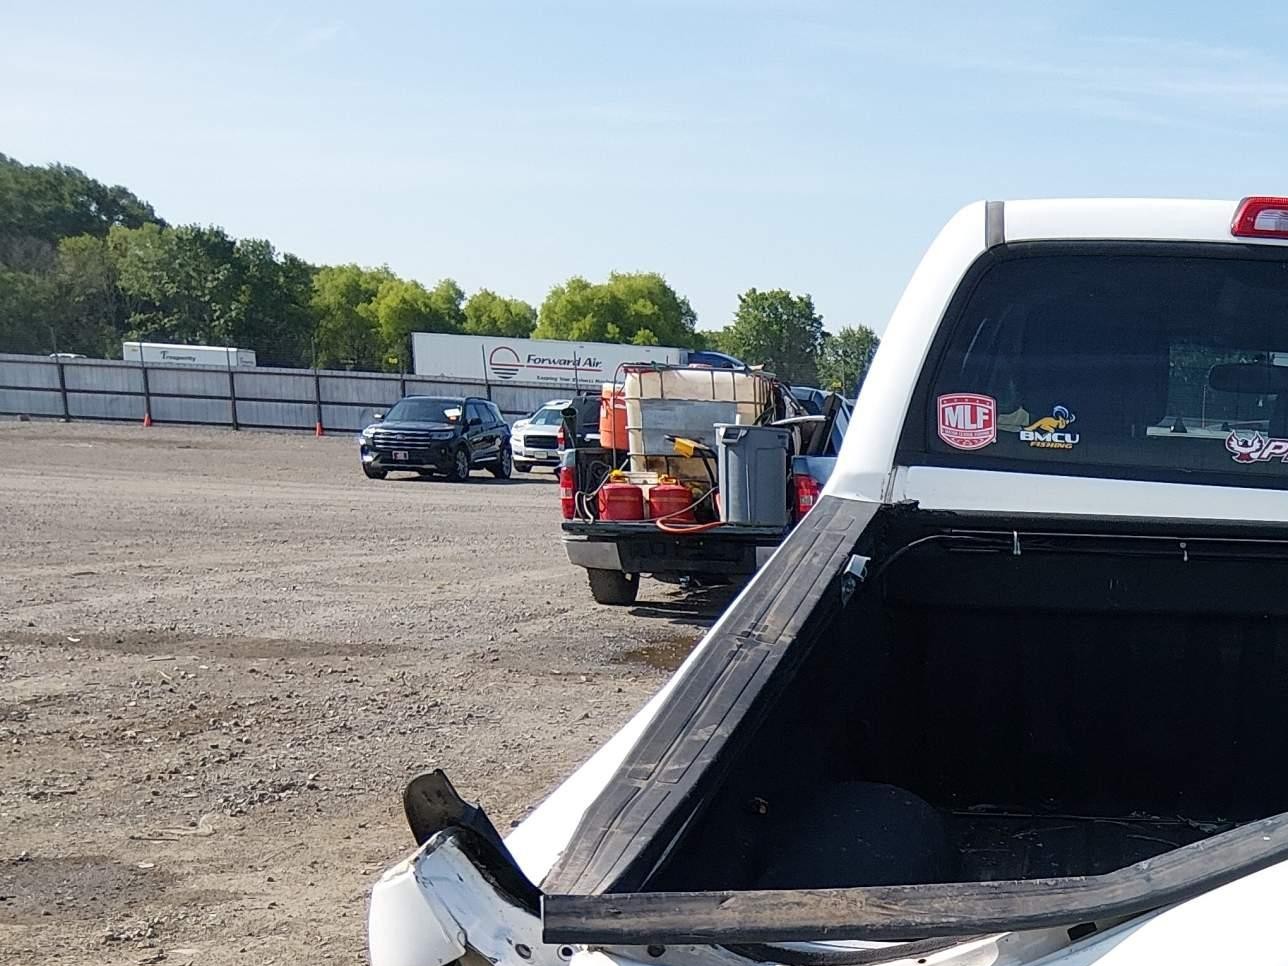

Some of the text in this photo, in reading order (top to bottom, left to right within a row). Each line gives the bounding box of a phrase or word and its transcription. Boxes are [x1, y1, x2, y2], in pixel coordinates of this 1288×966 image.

[526, 354, 602, 368] Forward Air
[944, 404, 990, 430] MLF
[1020, 431, 1079, 443] BMCU
[1030, 441, 1072, 449] FISHING
